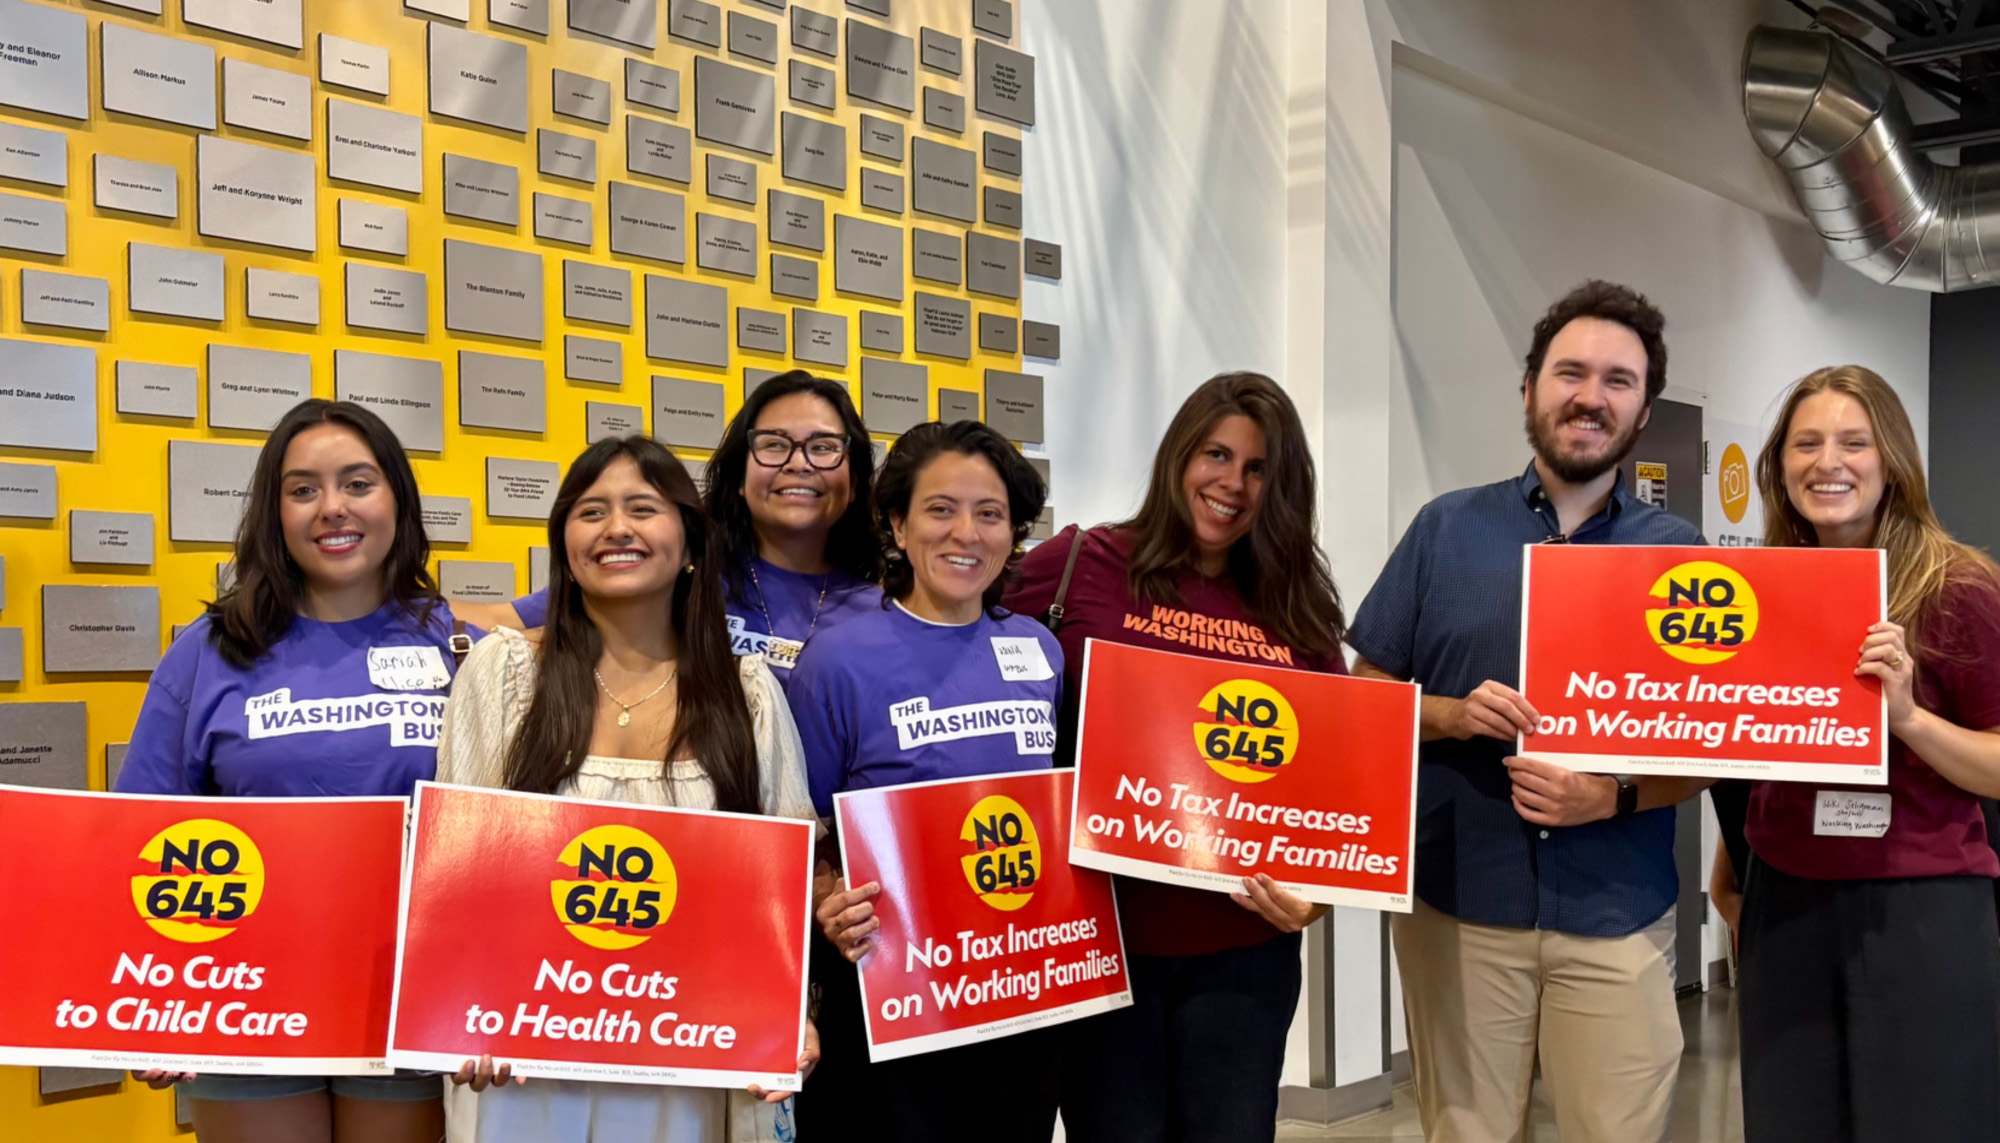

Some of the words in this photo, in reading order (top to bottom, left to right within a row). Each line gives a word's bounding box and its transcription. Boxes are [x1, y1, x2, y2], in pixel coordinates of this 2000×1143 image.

[7, 44, 24, 53] and
[27, 47, 61, 60] Eleanor
[133, 68, 158, 79] Allison
[160, 74, 185, 85] Markus
[461, 71, 477, 80] Katie
[478, 74, 498, 85] Quinn
[716, 98, 730, 107] Frank
[364, 141, 392, 152] Charlotte
[212, 184, 227, 192] Jeff
[229, 187, 243, 195] and
[245, 189, 275, 200] Korynne
[278, 195, 302, 205] Wright
[620, 215, 639, 224] George
[645, 220, 659, 228] Karen
[660, 223, 676, 231] Cowan
[466, 283, 478, 291] The
[479, 285, 503, 295] Blanton
[505, 289, 525, 299] Family
[703, 320, 720, 329] Durbin
[16, 389, 41, 398] Diana
[44, 392, 75, 401] Judson
[221, 382, 238, 391] Greg
[349, 394, 364, 403] Paul
[401, 399, 431, 409] Ellingson
[507, 389, 525, 397] Family
[1643, 466, 1664, 478] CAUTION
[204, 488, 230, 496] Robert
[1668, 577, 1735, 608] NO
[1123, 613, 1294, 666] WASHINGTON
[1152, 604, 1266, 643] WORKING
[1659, 612, 1745, 646] 645
[252, 692, 282, 709] THE
[1565, 671, 1616, 701] No
[1624, 673, 1683, 702] Tax
[1685, 674, 1840, 707] Increases
[261, 700, 445, 730] WASHINGTON
[895, 700, 924, 718] THE
[907, 706, 1050, 740] WASHINGTON
[1215, 692, 1278, 729] NO
[1025, 730, 1055, 749] BUS
[1536, 714, 1577, 736] on
[1586, 709, 1727, 748] Working
[1732, 713, 1871, 747] Families
[0, 746, 17, 754] and
[19, 746, 52, 754] Janette
[1204, 727, 1285, 768] 645
[1115, 774, 1162, 807] No
[1169, 783, 1224, 817] Tax
[1225, 792, 1371, 835] Increases
[973, 812, 1023, 850] NO
[1086, 814, 1124, 838] on
[1133, 814, 1263, 867] Working
[1266, 835, 1399, 876] Families
[160, 838, 240, 875] NO
[578, 842, 654, 883] NO
[975, 850, 1035, 893] 645
[146, 879, 247, 921] 645
[564, 885, 661, 929] 645
[905, 937, 952, 973] No
[957, 930, 1004, 963] Tax
[1008, 917, 1098, 955] Increases
[111, 952, 174, 988] No
[183, 955, 266, 990] Cuts
[534, 958, 592, 994] No
[600, 964, 678, 999] Cuts
[881, 994, 923, 1021] on
[929, 969, 1041, 1012] Working
[1044, 949, 1119, 989] Families
[55, 1000, 98, 1028] to
[107, 997, 208, 1034] Child
[215, 1002, 308, 1037] Care
[465, 1004, 504, 1034] to
[510, 1003, 641, 1043] Health
[650, 1013, 736, 1050] Care
